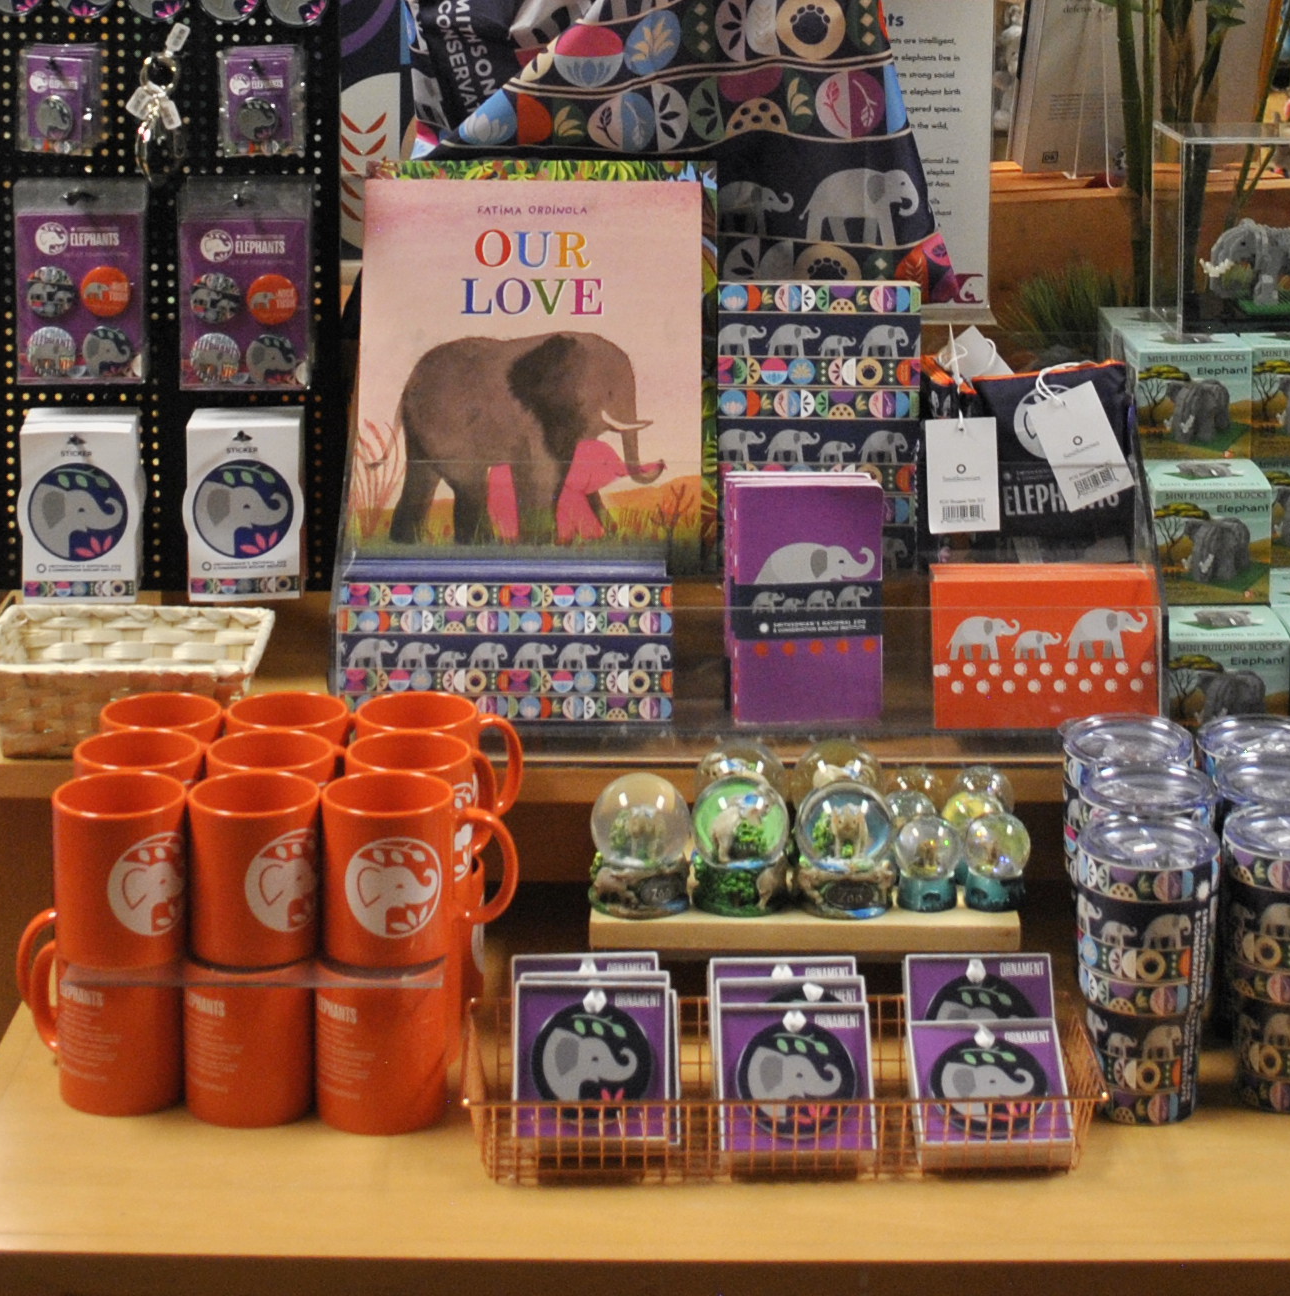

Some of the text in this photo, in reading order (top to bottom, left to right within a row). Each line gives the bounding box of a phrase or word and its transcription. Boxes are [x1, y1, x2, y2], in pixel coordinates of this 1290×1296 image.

[436, 0, 481, 114] CONSERVA
[477, 204, 588, 216] FATIMA ORDINOLA
[70, 232, 120, 248] ELEPHANTS
[235, 240, 286, 255] ELEPHANTS
[475, 229, 592, 268] OUR
[461, 277, 604, 316] LOVE
[1147, 353, 1246, 363] MINI BUILDING BLOCKS
[1261, 349, 1281, 358] MINI
[1196, 366, 1249, 377] Elephant
[60, 450, 93, 458] STICKER
[225, 446, 259, 454] STICKER
[1165, 490, 1268, 501] MINI BUILDING BLOCKS
[1216, 502, 1270, 514] Elephant
[1178, 642, 1284, 652] MINI BUILDING BLOCKS
[1229, 655, 1285, 667] Elephant
[1000, 961, 1044, 976] ORNAMENT
[615, 992, 660, 1007] ORNAMENT
[815, 1014, 860, 1028] ORNAMENT
[1004, 1030, 1050, 1043] ORNAMENT
